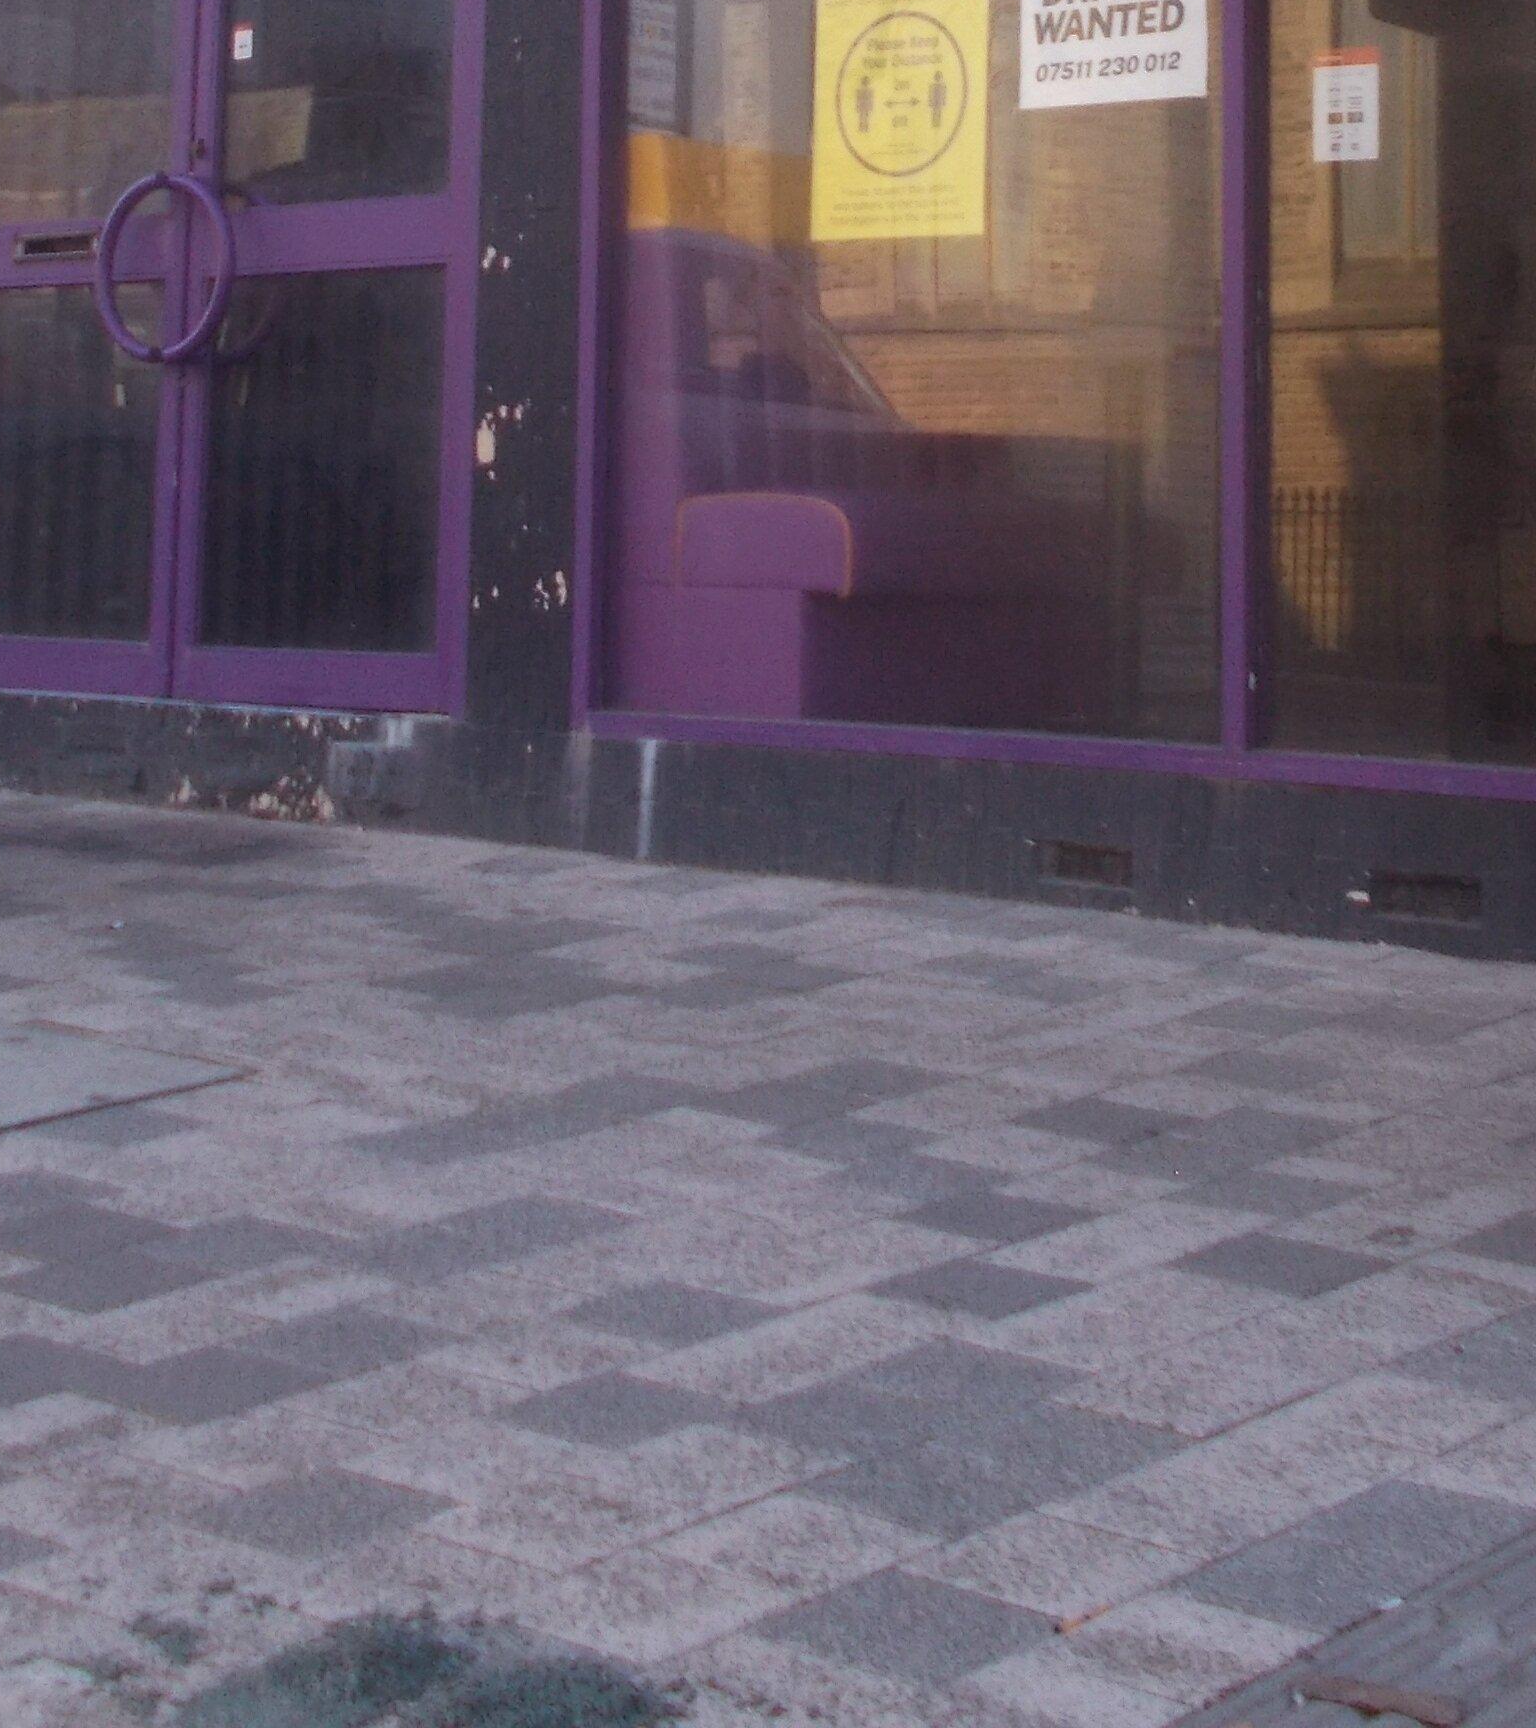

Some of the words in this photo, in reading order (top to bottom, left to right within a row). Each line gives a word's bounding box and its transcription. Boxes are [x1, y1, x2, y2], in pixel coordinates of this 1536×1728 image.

[1036, 58, 1093, 83] 07511
[1099, 54, 1140, 78] 230
[1144, 50, 1182, 73] 012
